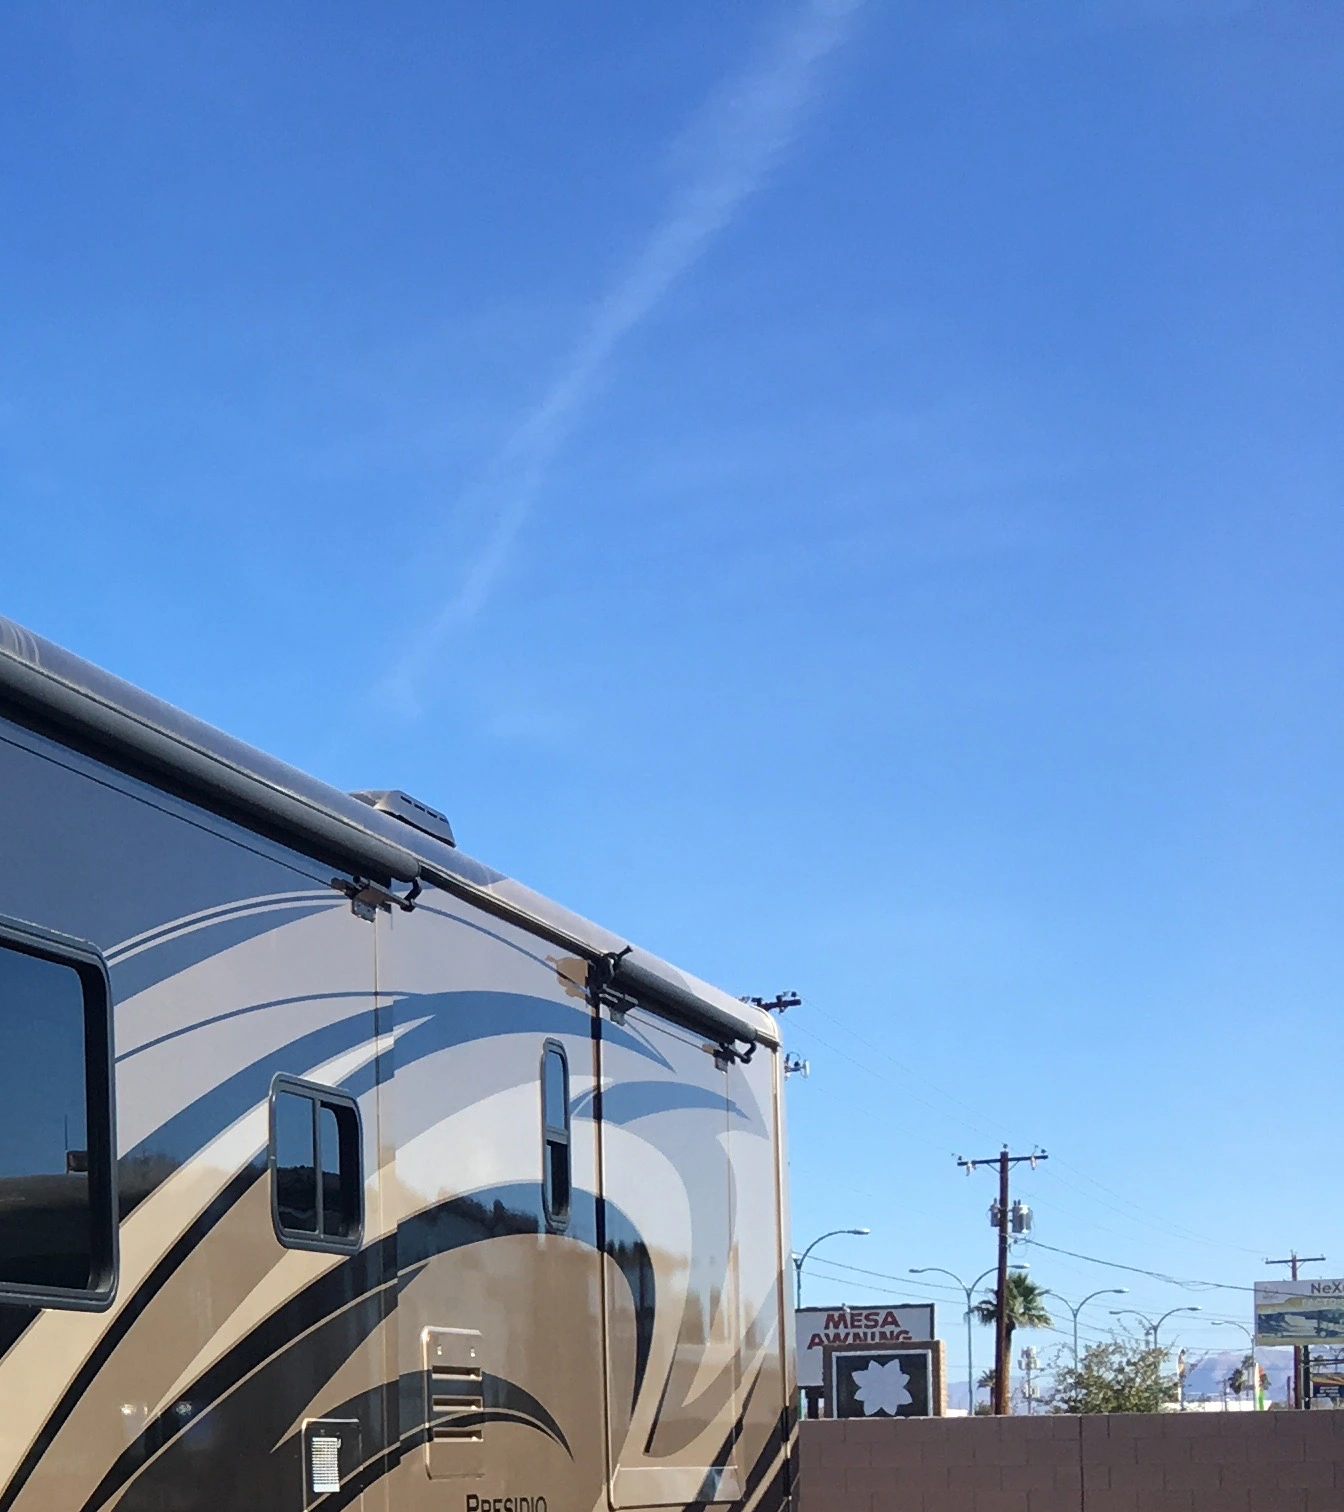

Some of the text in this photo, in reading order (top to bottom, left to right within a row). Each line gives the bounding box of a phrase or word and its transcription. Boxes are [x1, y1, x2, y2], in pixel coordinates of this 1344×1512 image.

[1311, 1281, 1344, 1295] NeX
[824, 1310, 900, 1330] MESA
[807, 1330, 912, 1349] AWNING
